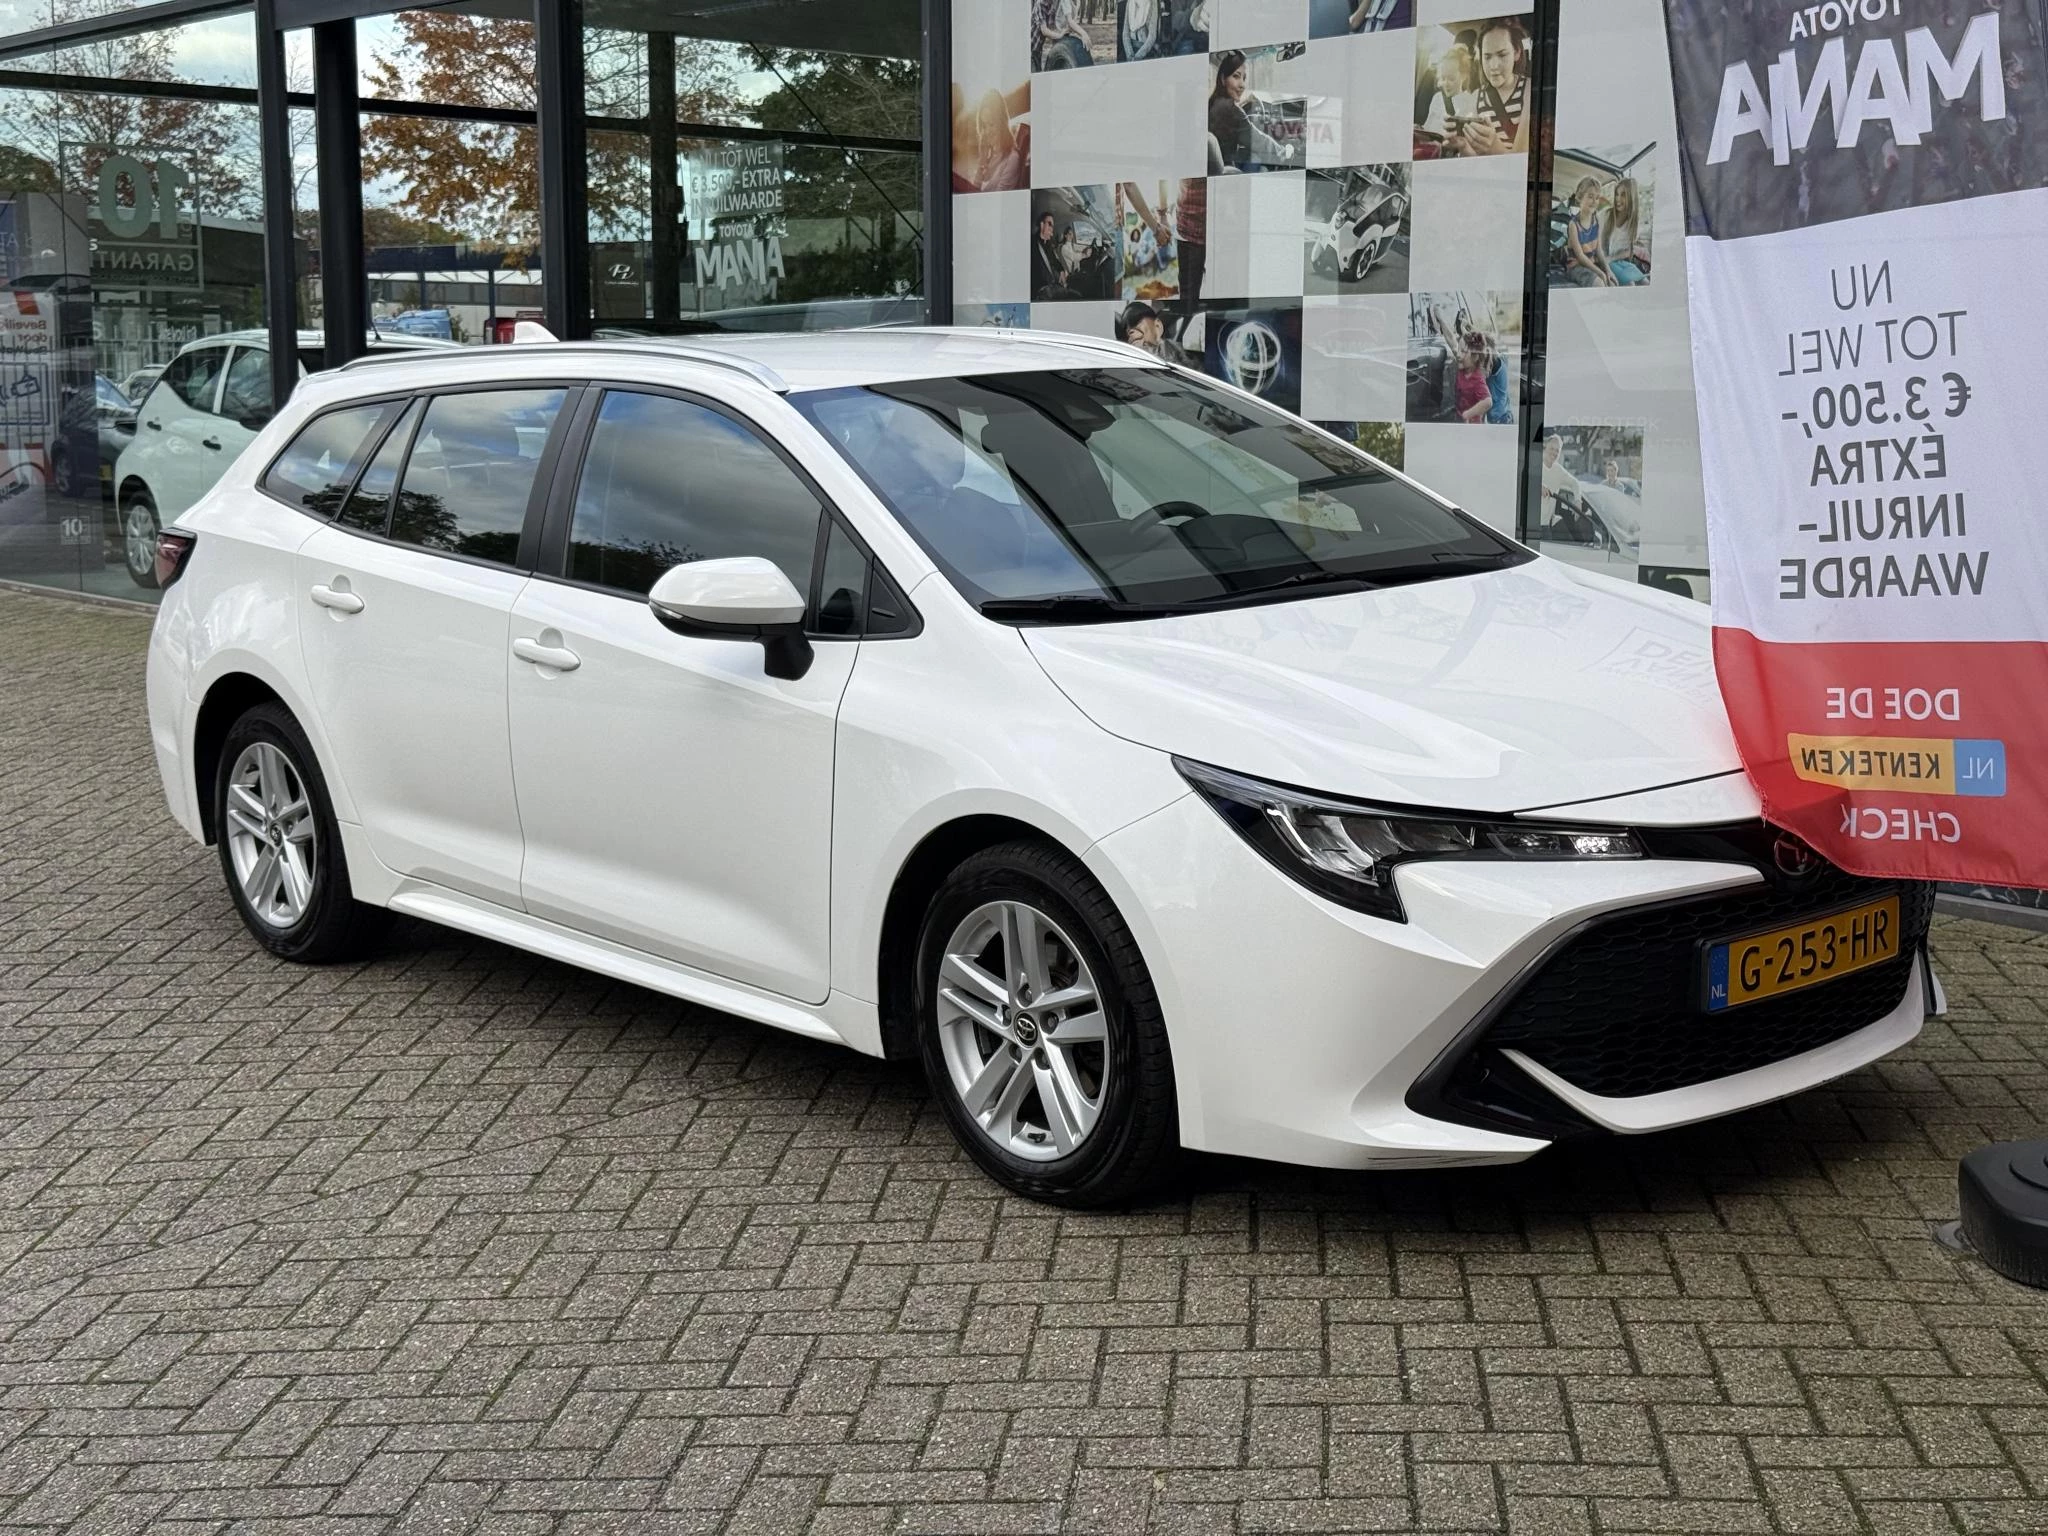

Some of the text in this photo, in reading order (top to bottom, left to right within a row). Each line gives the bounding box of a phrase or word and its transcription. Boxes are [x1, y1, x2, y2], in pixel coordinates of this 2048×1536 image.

[720, 149, 743, 168] TOT
[745, 145, 772, 166] WEL
[742, 166, 782, 189] ÉXTRA
[719, 223, 755, 238] TOYOTA
[695, 236, 786, 291] MANIA
[1711, 908, 1889, 999] NL G-253-HR
